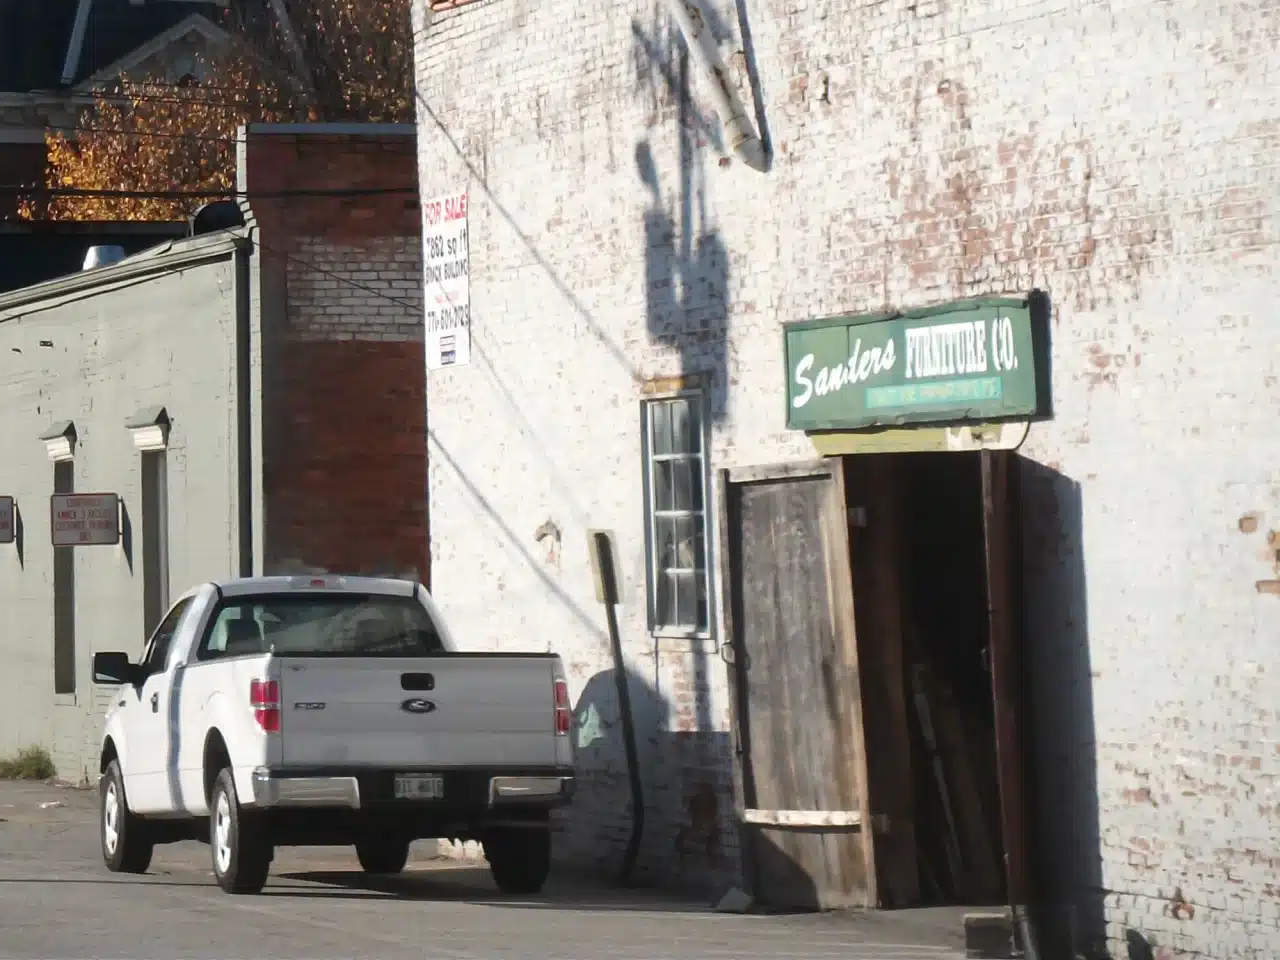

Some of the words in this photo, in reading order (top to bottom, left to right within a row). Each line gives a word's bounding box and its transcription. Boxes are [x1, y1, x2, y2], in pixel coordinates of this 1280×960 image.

[424, 202, 442, 226] FOR
[444, 194, 467, 222] SALE
[447, 237, 458, 258] sq
[792, 338, 897, 408] Sanders
[904, 320, 988, 379] FURNITURE
[991, 316, 1019, 372] CO.
